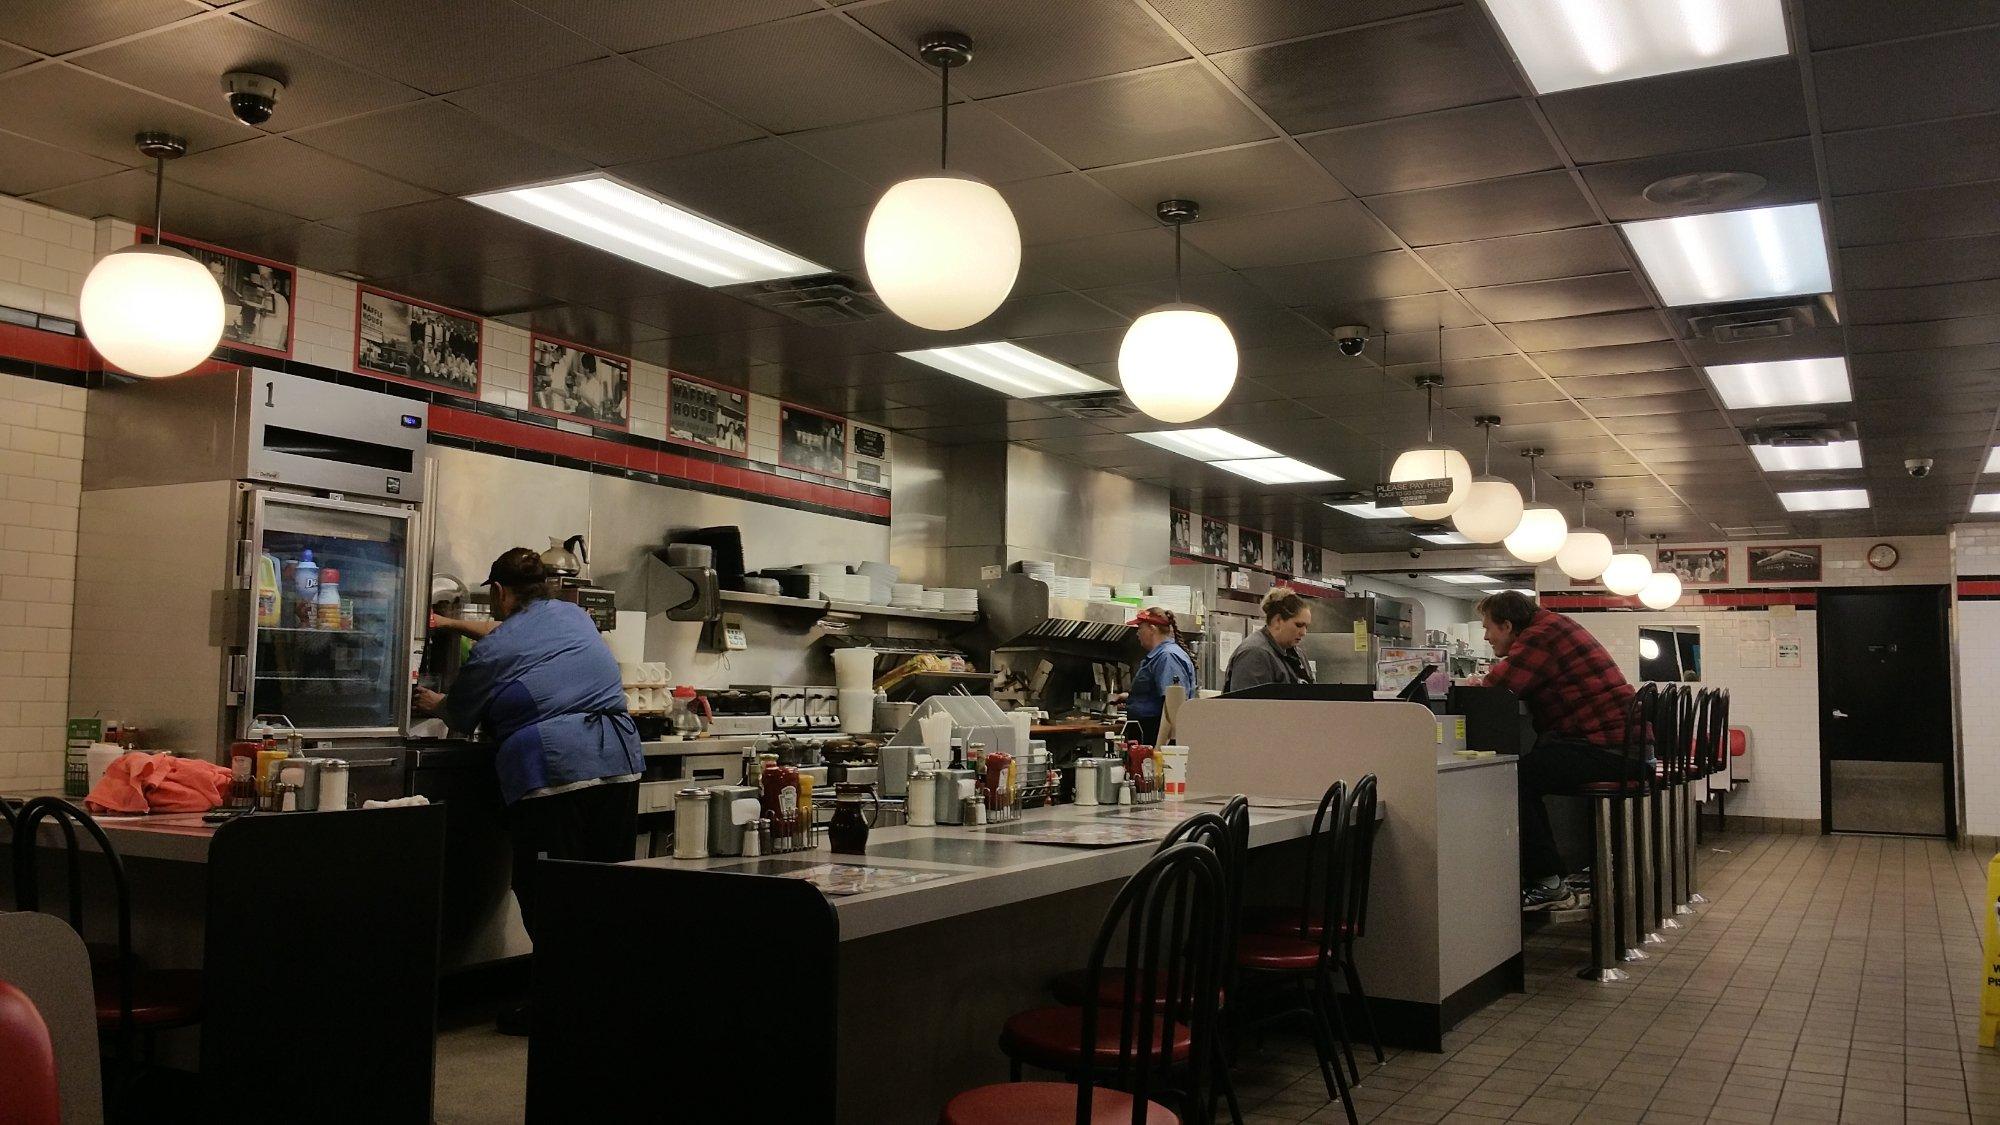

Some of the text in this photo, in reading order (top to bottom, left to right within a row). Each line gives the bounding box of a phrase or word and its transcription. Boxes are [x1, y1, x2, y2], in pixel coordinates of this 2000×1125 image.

[264, 381, 275, 408] 1
[673, 401, 715, 424] HOUSE
[1376, 480, 1451, 492] PLEASE PAY HERE
